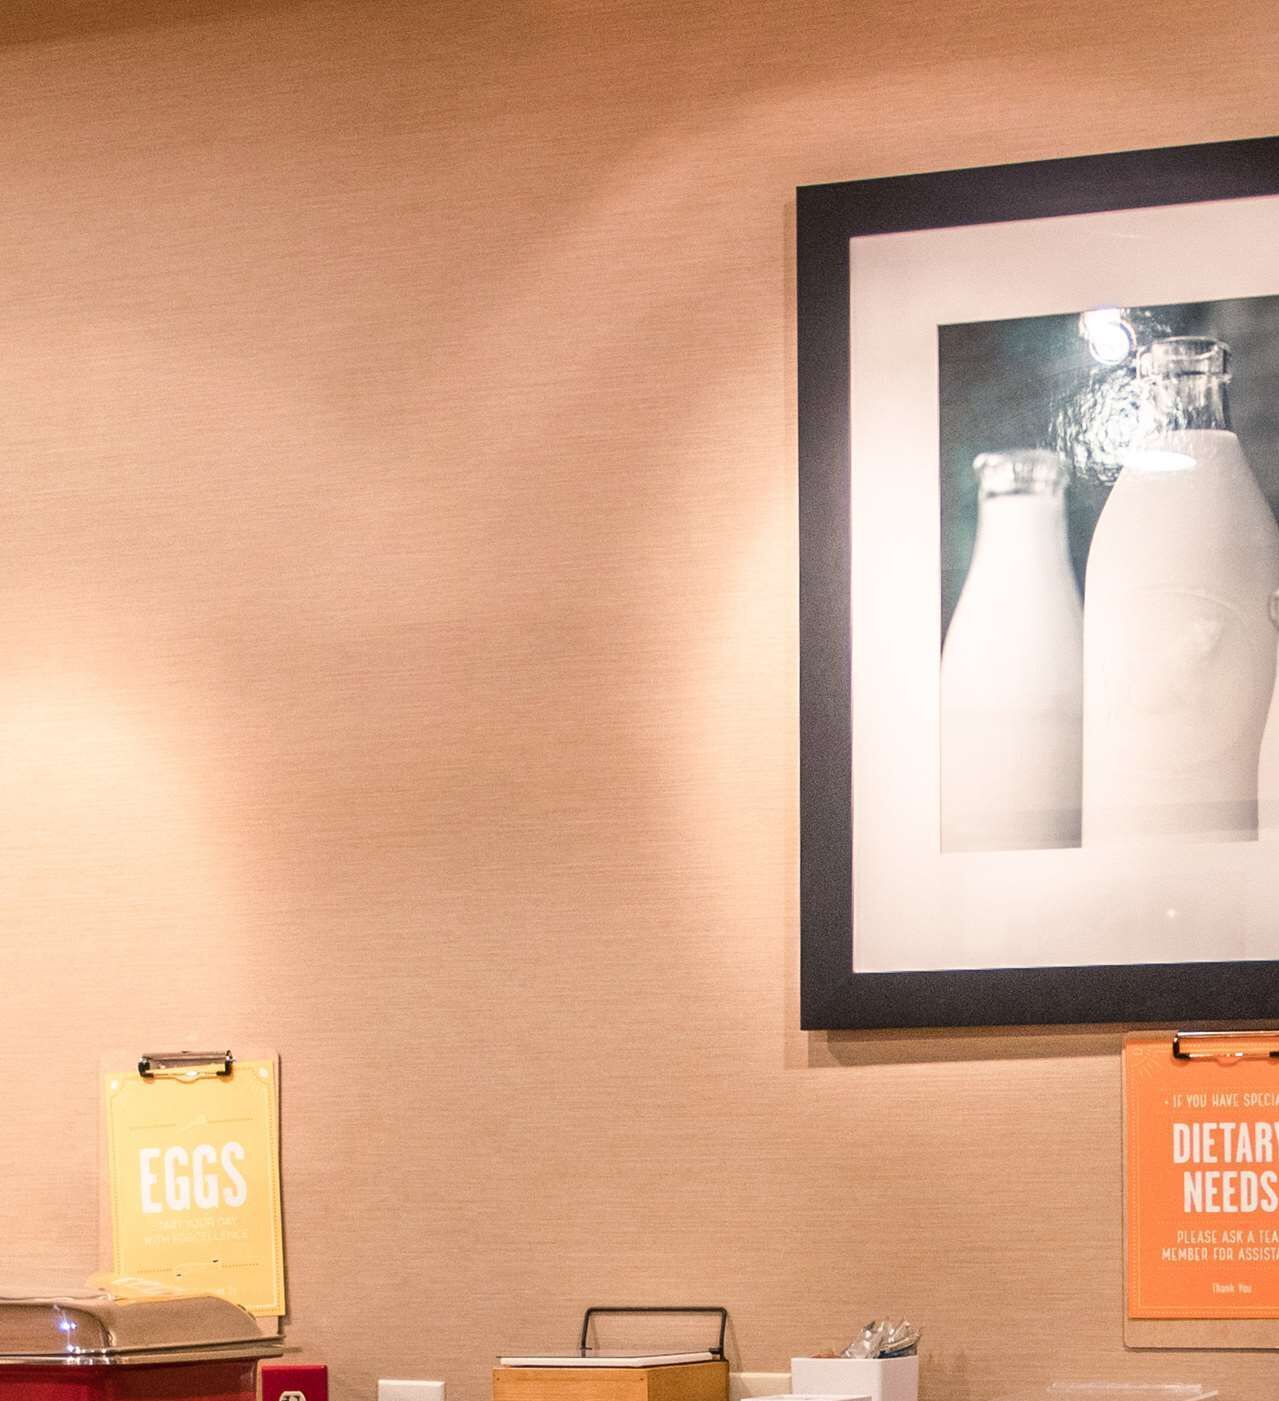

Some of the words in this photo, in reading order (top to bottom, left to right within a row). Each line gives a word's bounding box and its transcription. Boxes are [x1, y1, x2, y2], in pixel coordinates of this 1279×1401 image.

[1185, 1094, 1207, 1108] YOU
[1212, 1093, 1239, 1108] HAVE
[138, 1141, 248, 1215] EGGS
[1183, 1170, 1279, 1213] NEEDS
[1177, 1230, 1217, 1244] PLEASE
[1222, 1230, 1243, 1244] ASK
[1247, 1230, 1255, 1244] A
[1161, 1246, 1208, 1261] MEMBER
[1213, 1246, 1233, 1261] FOR
